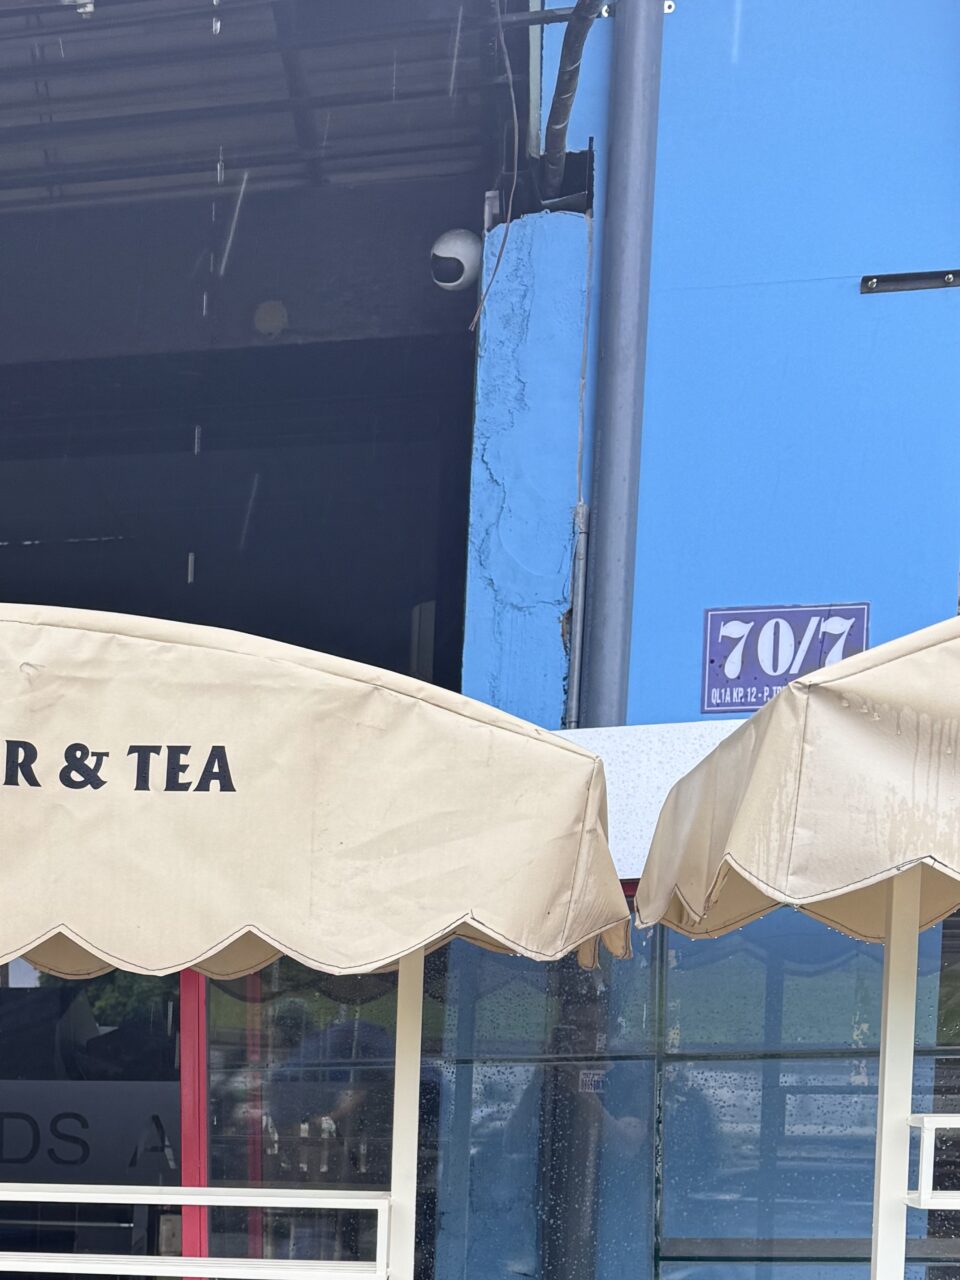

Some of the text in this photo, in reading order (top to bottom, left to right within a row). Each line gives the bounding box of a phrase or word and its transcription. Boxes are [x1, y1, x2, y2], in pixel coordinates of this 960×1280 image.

[718, 616, 856, 679] 70/7
[711, 687, 731, 704] QL1A
[732, 687, 745, 702] KP.
[747, 687, 757, 702] 12
[763, 686, 771, 702] P.
[59, 743, 109, 790] &
[127, 745, 237, 792] TEA
